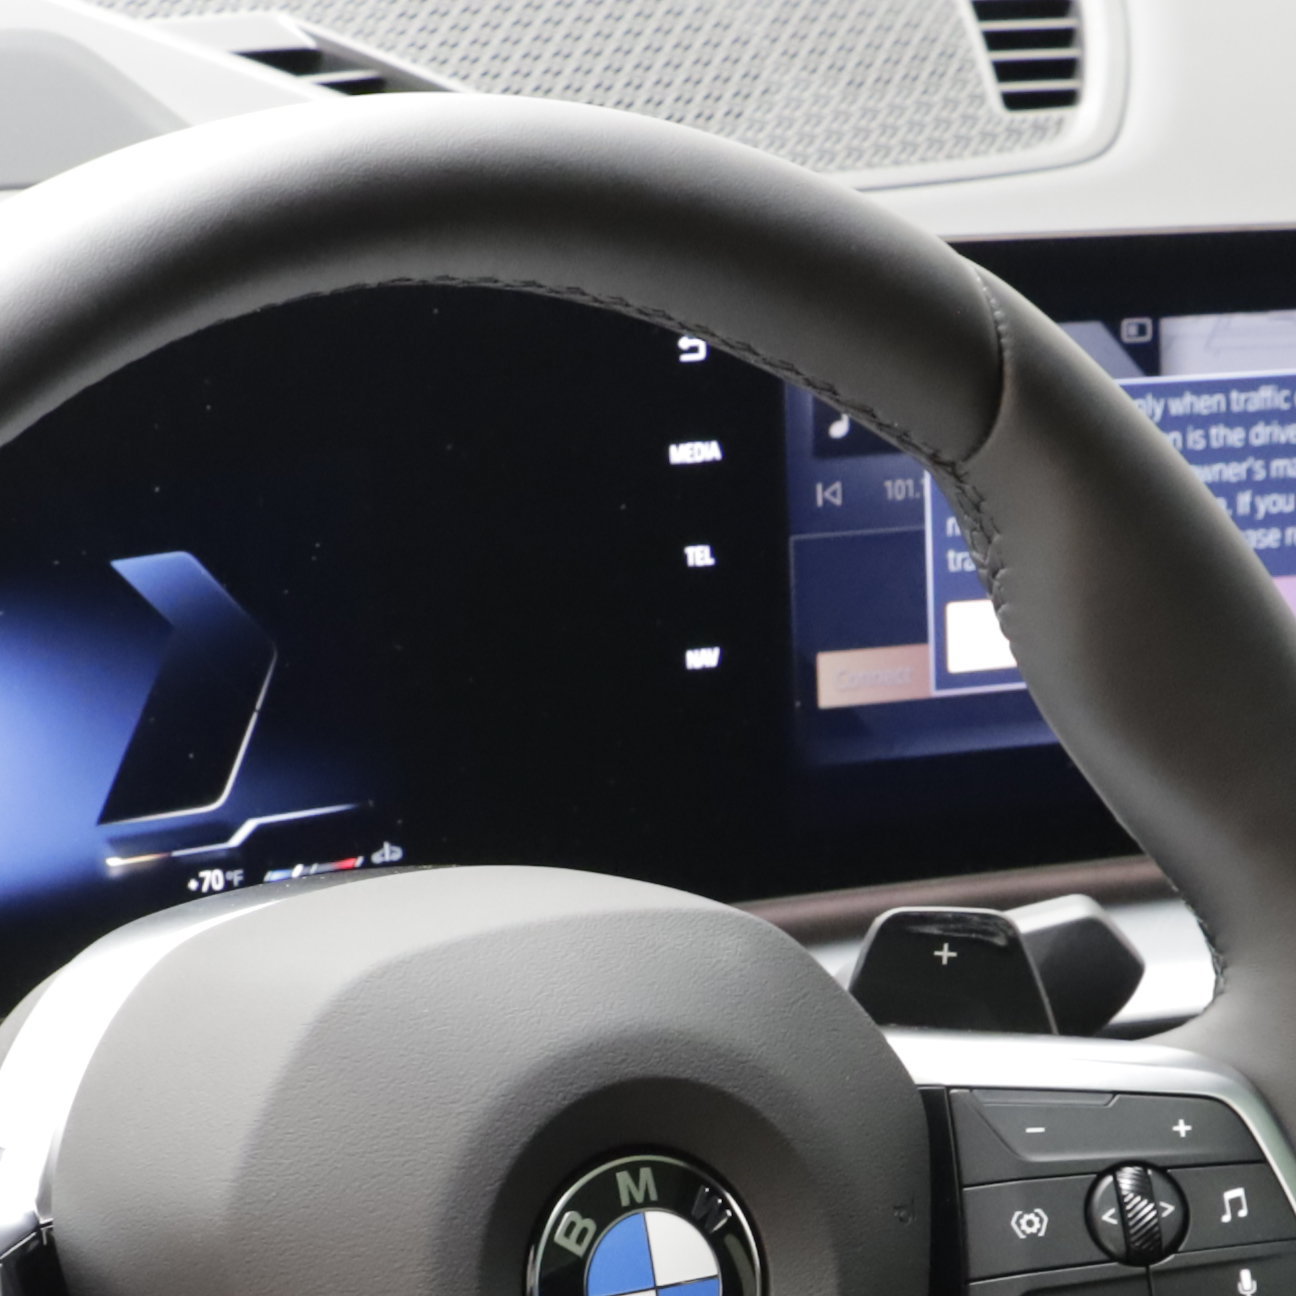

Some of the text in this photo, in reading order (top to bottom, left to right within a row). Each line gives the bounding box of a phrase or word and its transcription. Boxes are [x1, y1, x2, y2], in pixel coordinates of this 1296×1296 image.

[1167, 391, 1226, 416] when
[1230, 384, 1291, 413] traffic
[1187, 425, 1207, 451] is
[1209, 423, 1246, 449] the
[669, 440, 722, 465] MEDIA
[1194, 457, 1267, 483] wner's
[1236, 489, 1253, 517] If
[1255, 491, 1294, 521] you
[684, 545, 715, 567] TEL
[685, 647, 720, 670] NAV
